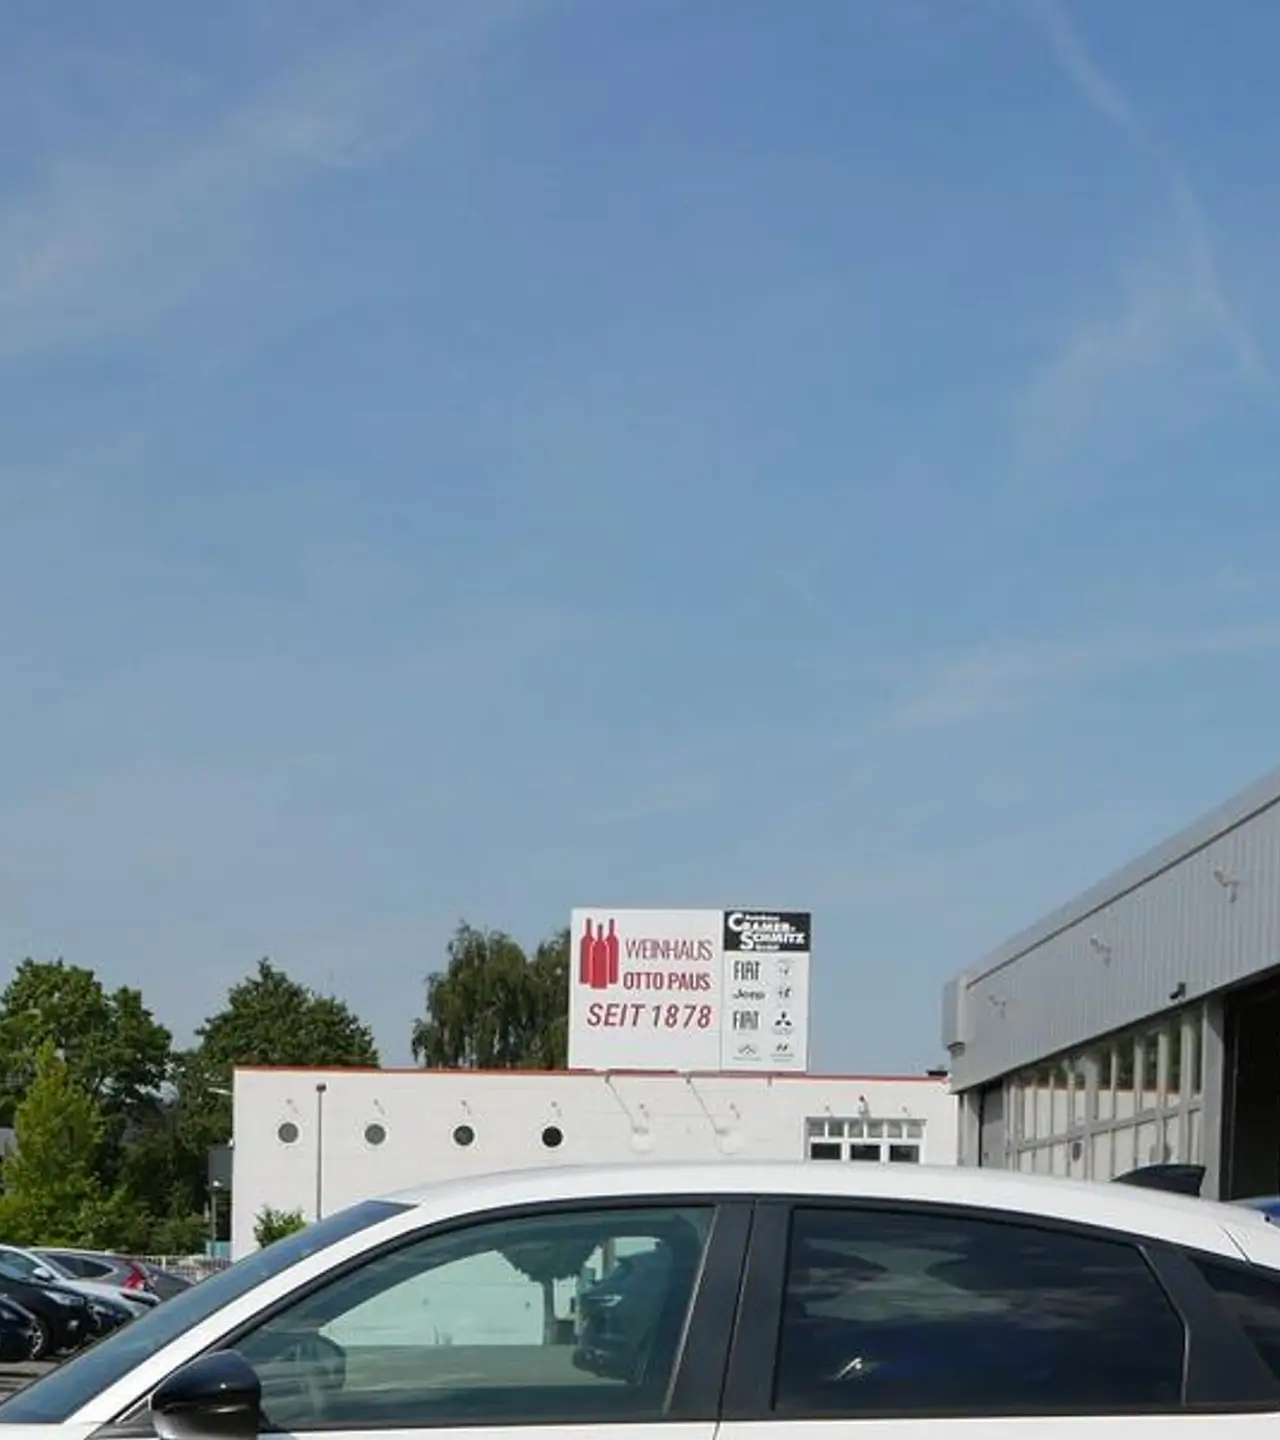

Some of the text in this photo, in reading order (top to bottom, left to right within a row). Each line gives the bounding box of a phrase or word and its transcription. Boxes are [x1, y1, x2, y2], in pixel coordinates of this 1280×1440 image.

[625, 938, 713, 962] WEINHAUS
[733, 959, 761, 981] FIAT
[623, 971, 711, 992] OTTO PAUS
[732, 987, 766, 1002] Jeep
[586, 1002, 712, 1030] SEIT 1878
[732, 1010, 759, 1031] FIAT
